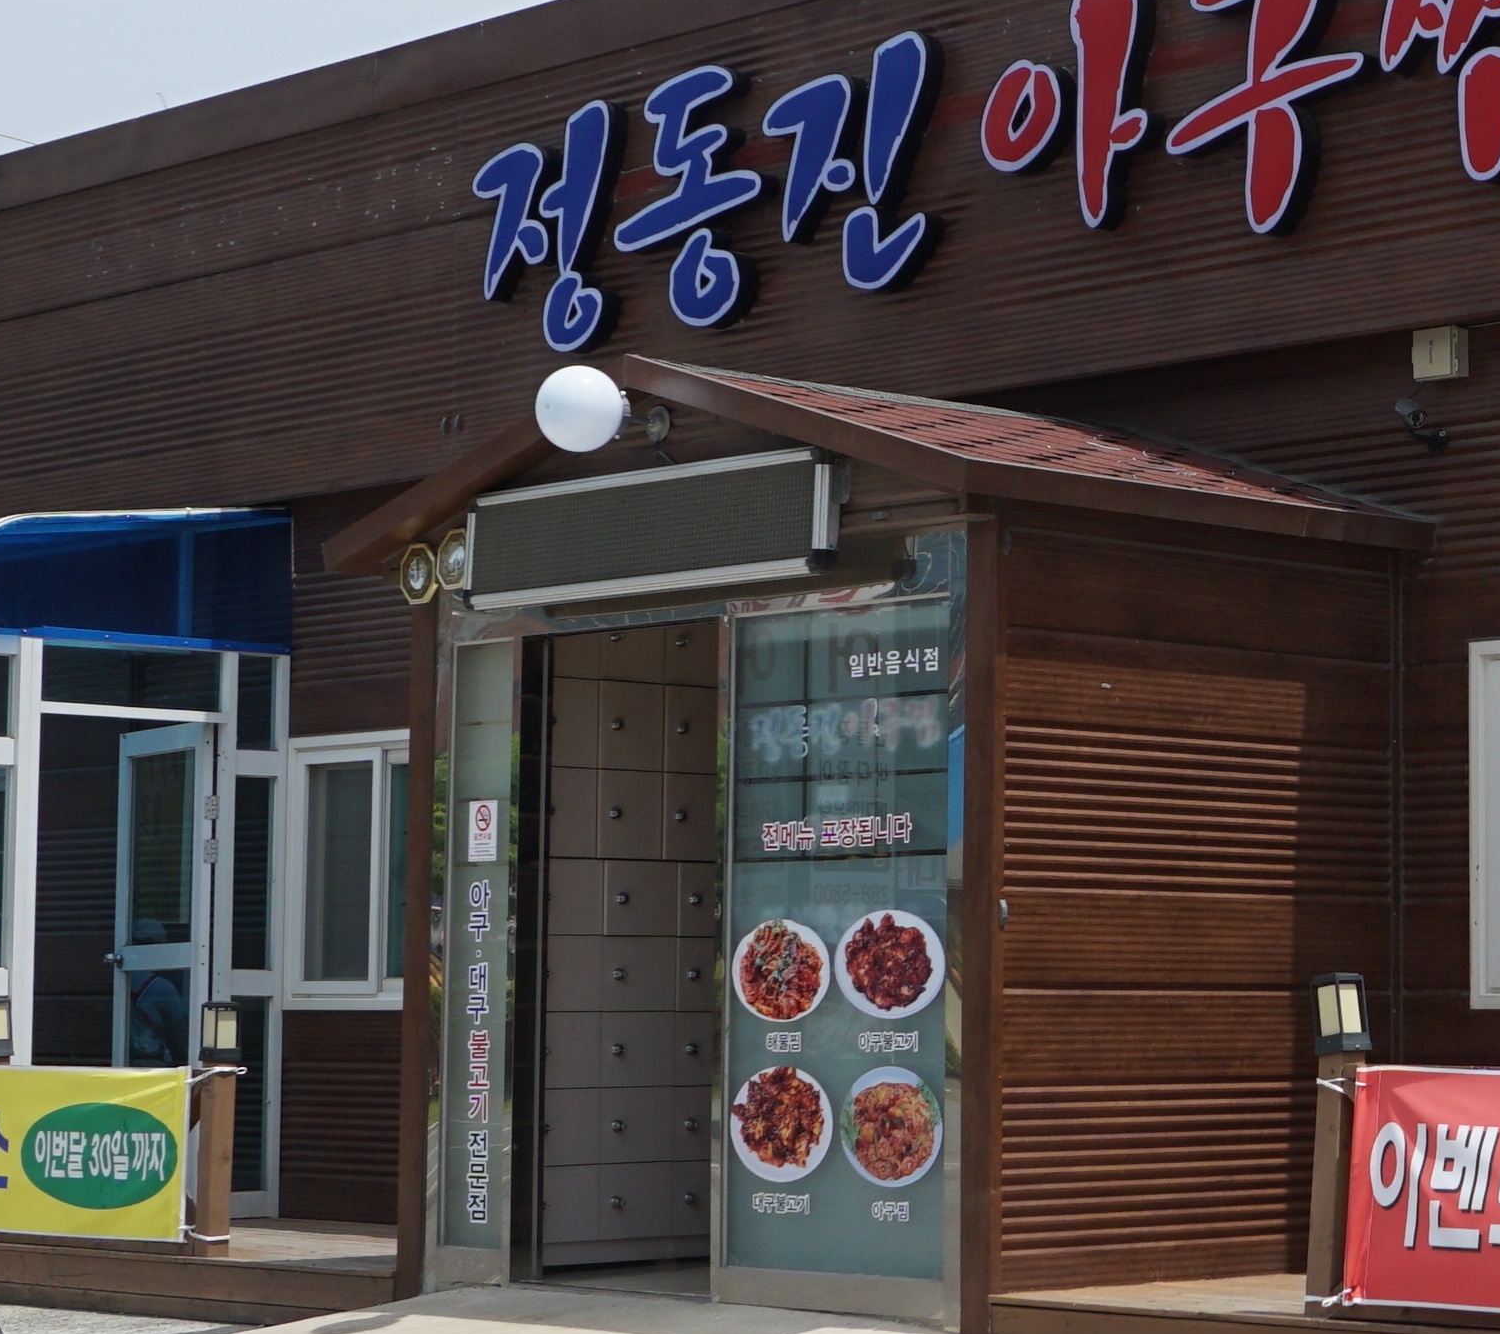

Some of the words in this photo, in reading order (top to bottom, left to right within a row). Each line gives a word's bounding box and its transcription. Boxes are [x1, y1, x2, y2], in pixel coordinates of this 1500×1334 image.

[472, 30, 932, 354] 정동진
[848, 646, 940, 679] 일반음식점
[761, 820, 816, 851] 전메뉴
[819, 812, 913, 848] 포장됩니다
[765, 1031, 802, 1053] 해물찜
[857, 1031, 919, 1053] 아구불고기
[466, 1029, 491, 1124] 불고기
[34, 1129, 88, 1179] 이번달
[466, 1128, 490, 1224] 전문점
[752, 1192, 811, 1215] 대구불고기
[871, 1200, 910, 1223] 아구찜
